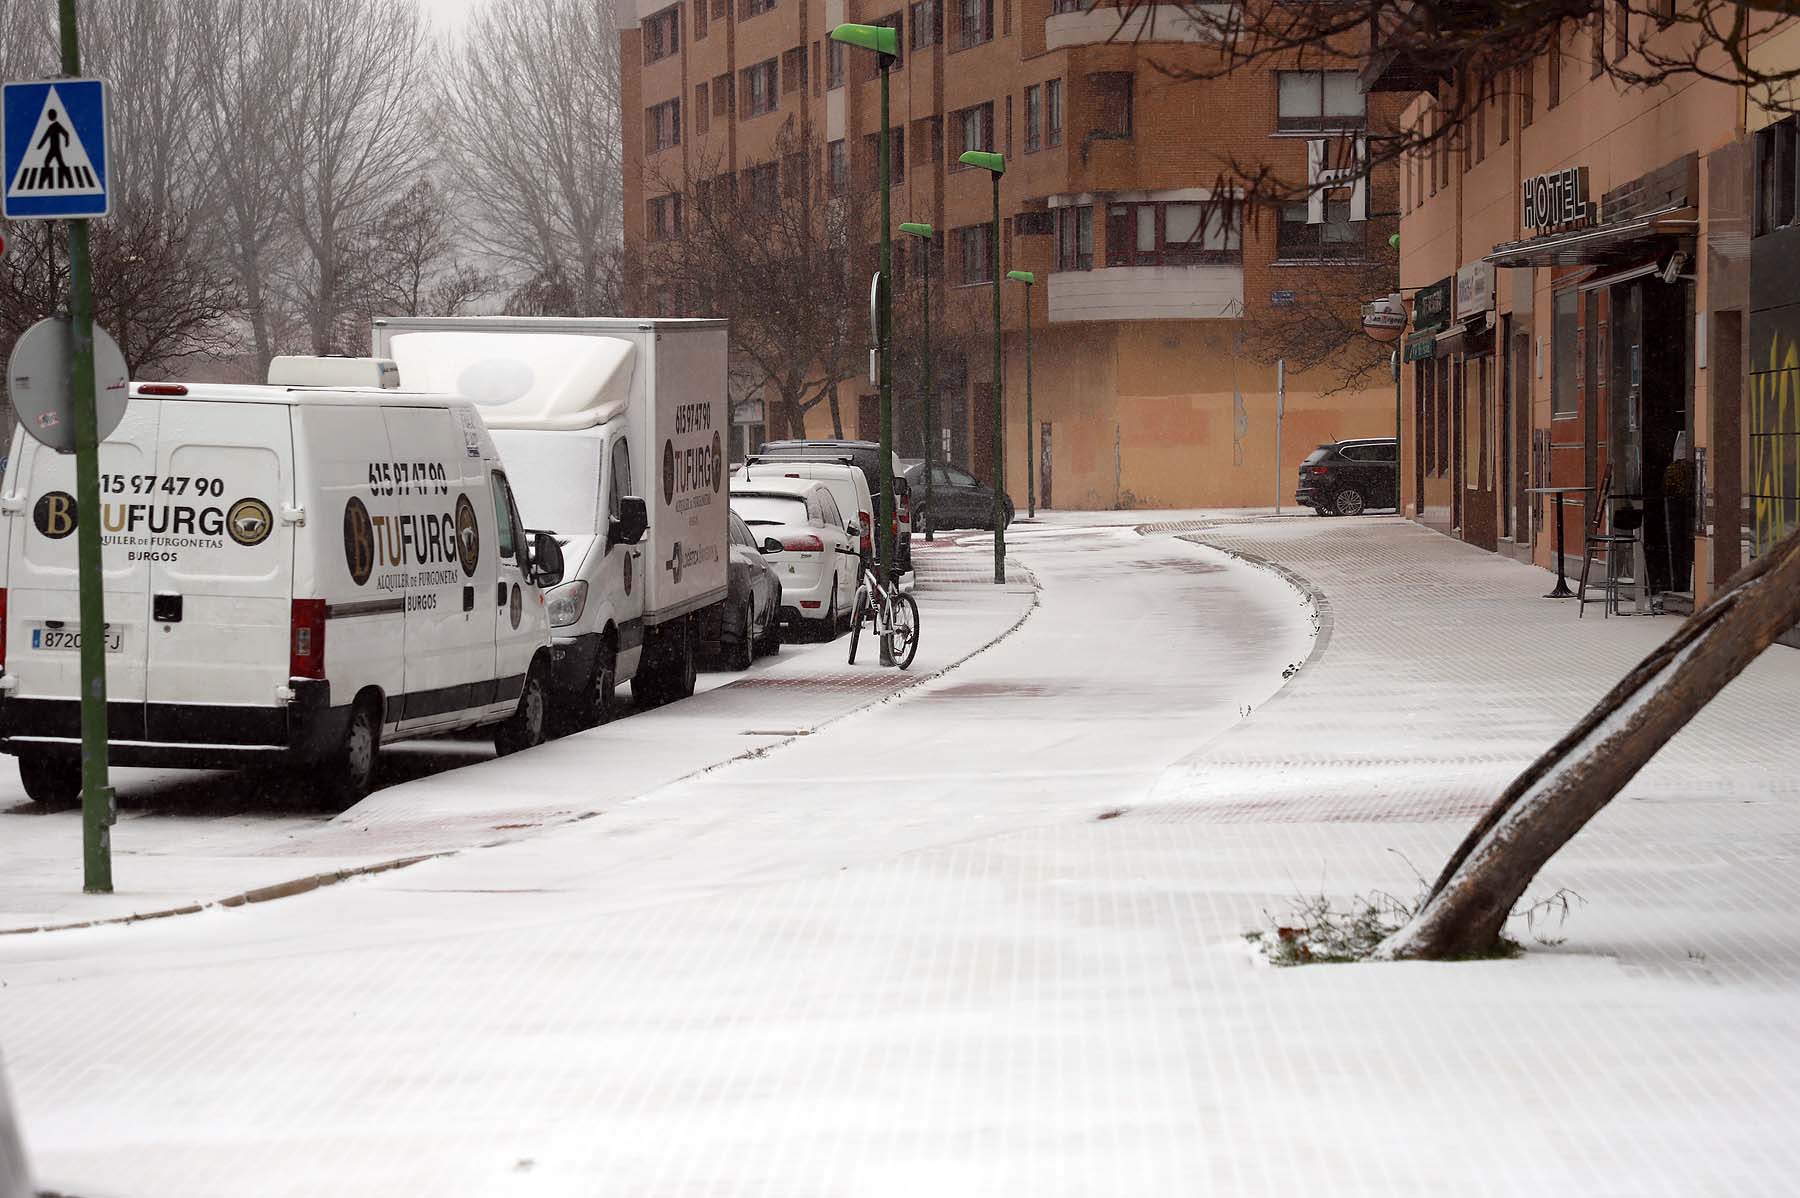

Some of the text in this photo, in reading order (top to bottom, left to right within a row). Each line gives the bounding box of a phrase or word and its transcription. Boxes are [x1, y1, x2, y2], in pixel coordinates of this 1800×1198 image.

[1306, 137, 1367, 225] H
[1523, 168, 1587, 230] HOTEL
[99, 474, 224, 497] 15 97 47 90
[368, 462, 448, 496] 615 97 47 90
[45, 495, 224, 536] B UFURG
[151, 537, 223, 549] FURGONETAS
[128, 551, 178, 562] BURGOS
[376, 574, 410, 593] ALQUILER
[418, 569, 458, 587] FURGONETAS
[407, 594, 437, 612] BURGOS
